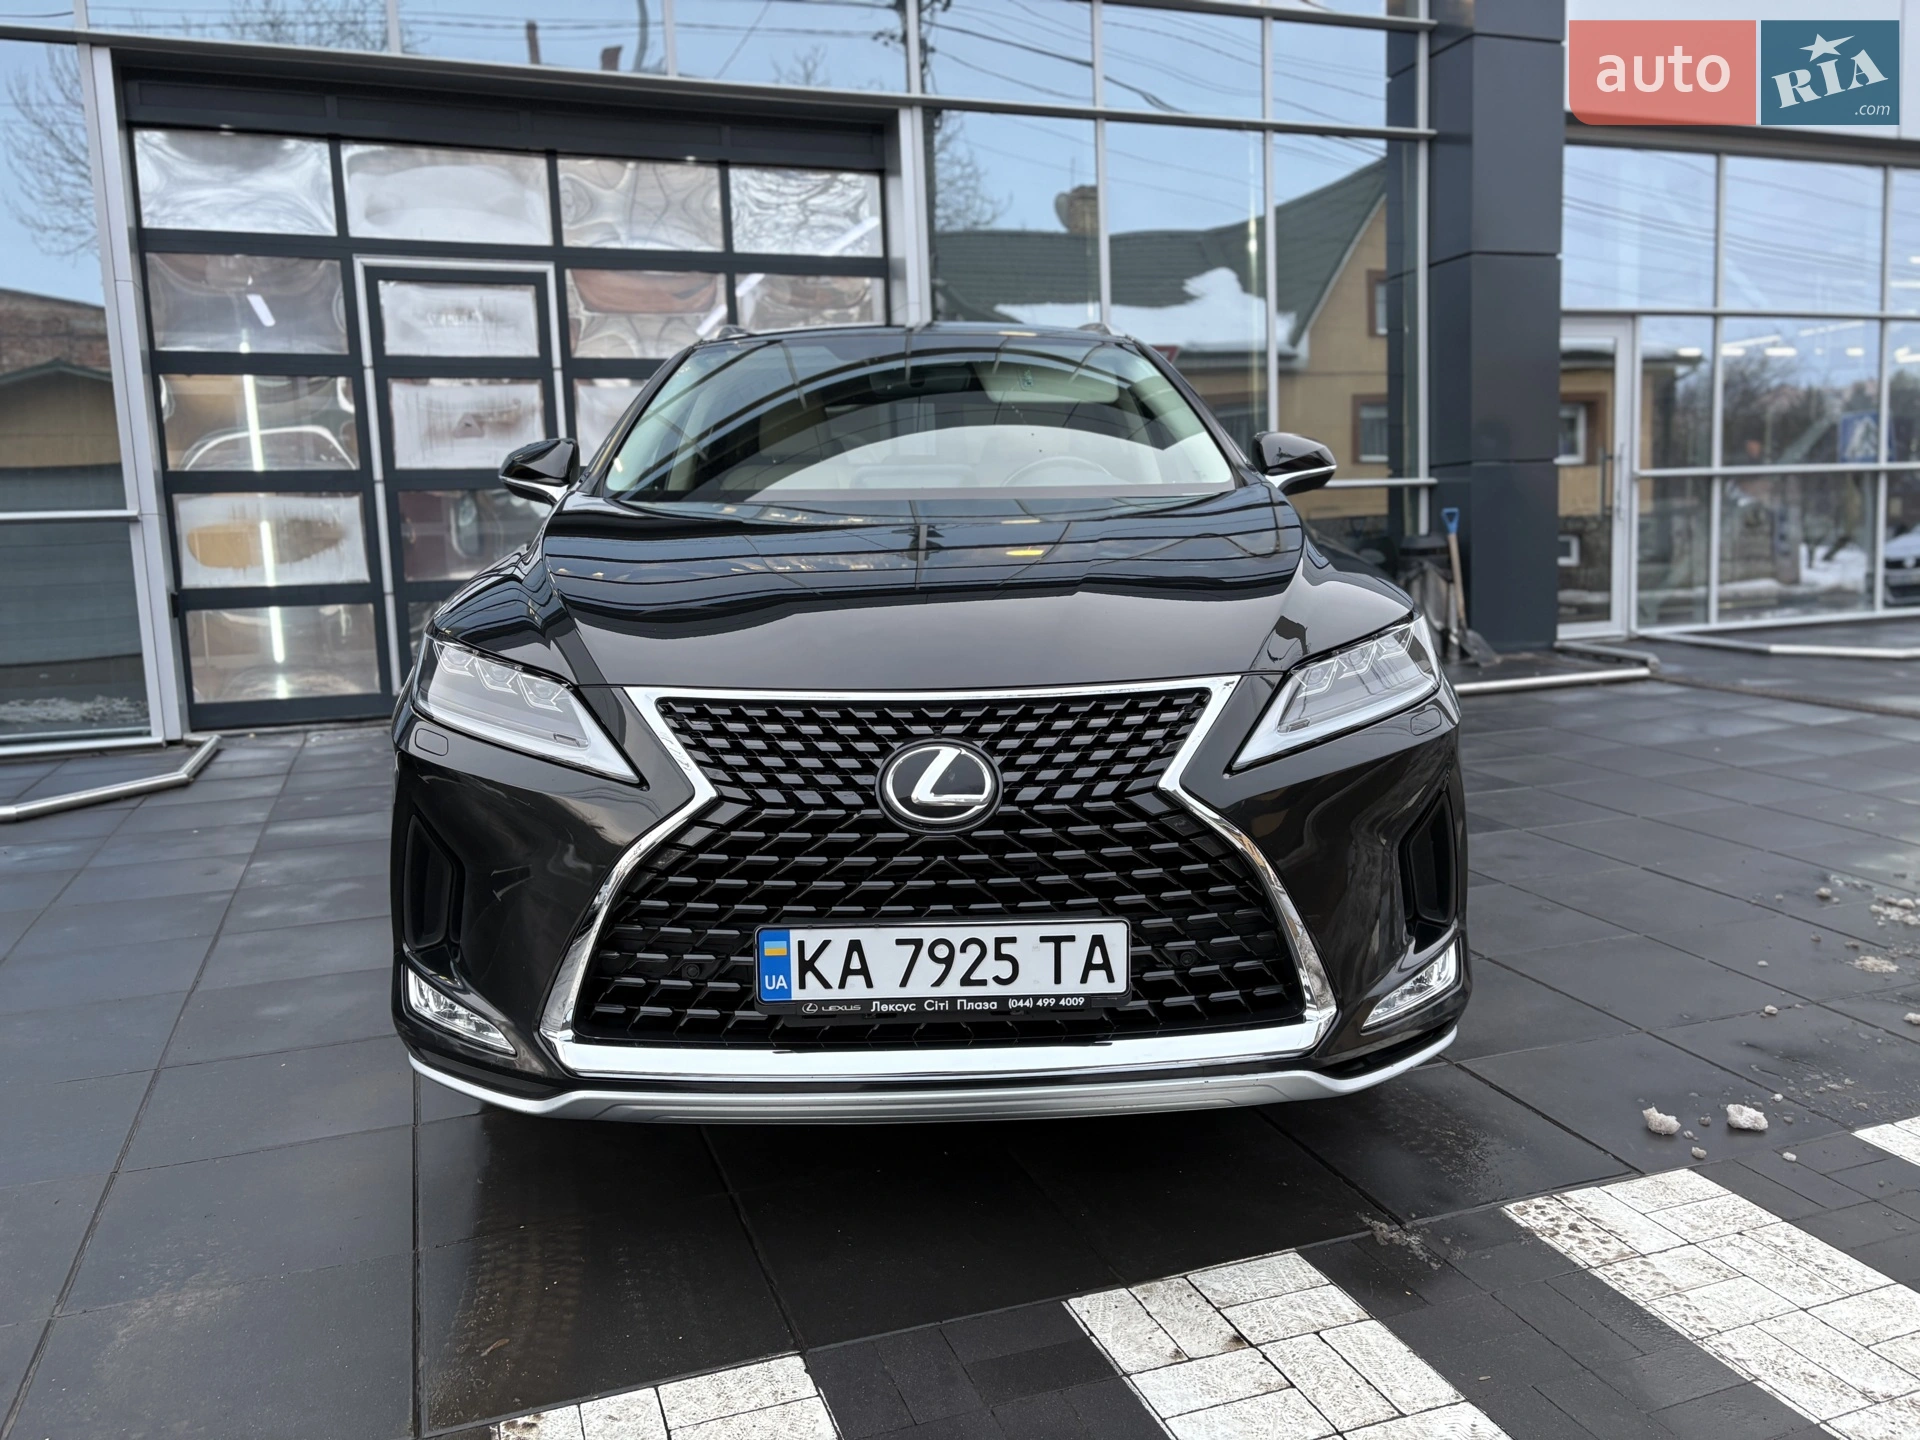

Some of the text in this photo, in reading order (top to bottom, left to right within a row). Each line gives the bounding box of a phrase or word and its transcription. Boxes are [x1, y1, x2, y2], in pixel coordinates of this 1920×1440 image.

[797, 934, 1116, 990] KA 7925 TA
[764, 975, 788, 990] UA
[821, 1004, 862, 1012] LEXUS
[870, 999, 998, 1013] Лексус Сіті Плаза
[1008, 997, 1085, 1009] (044) 499 4009
